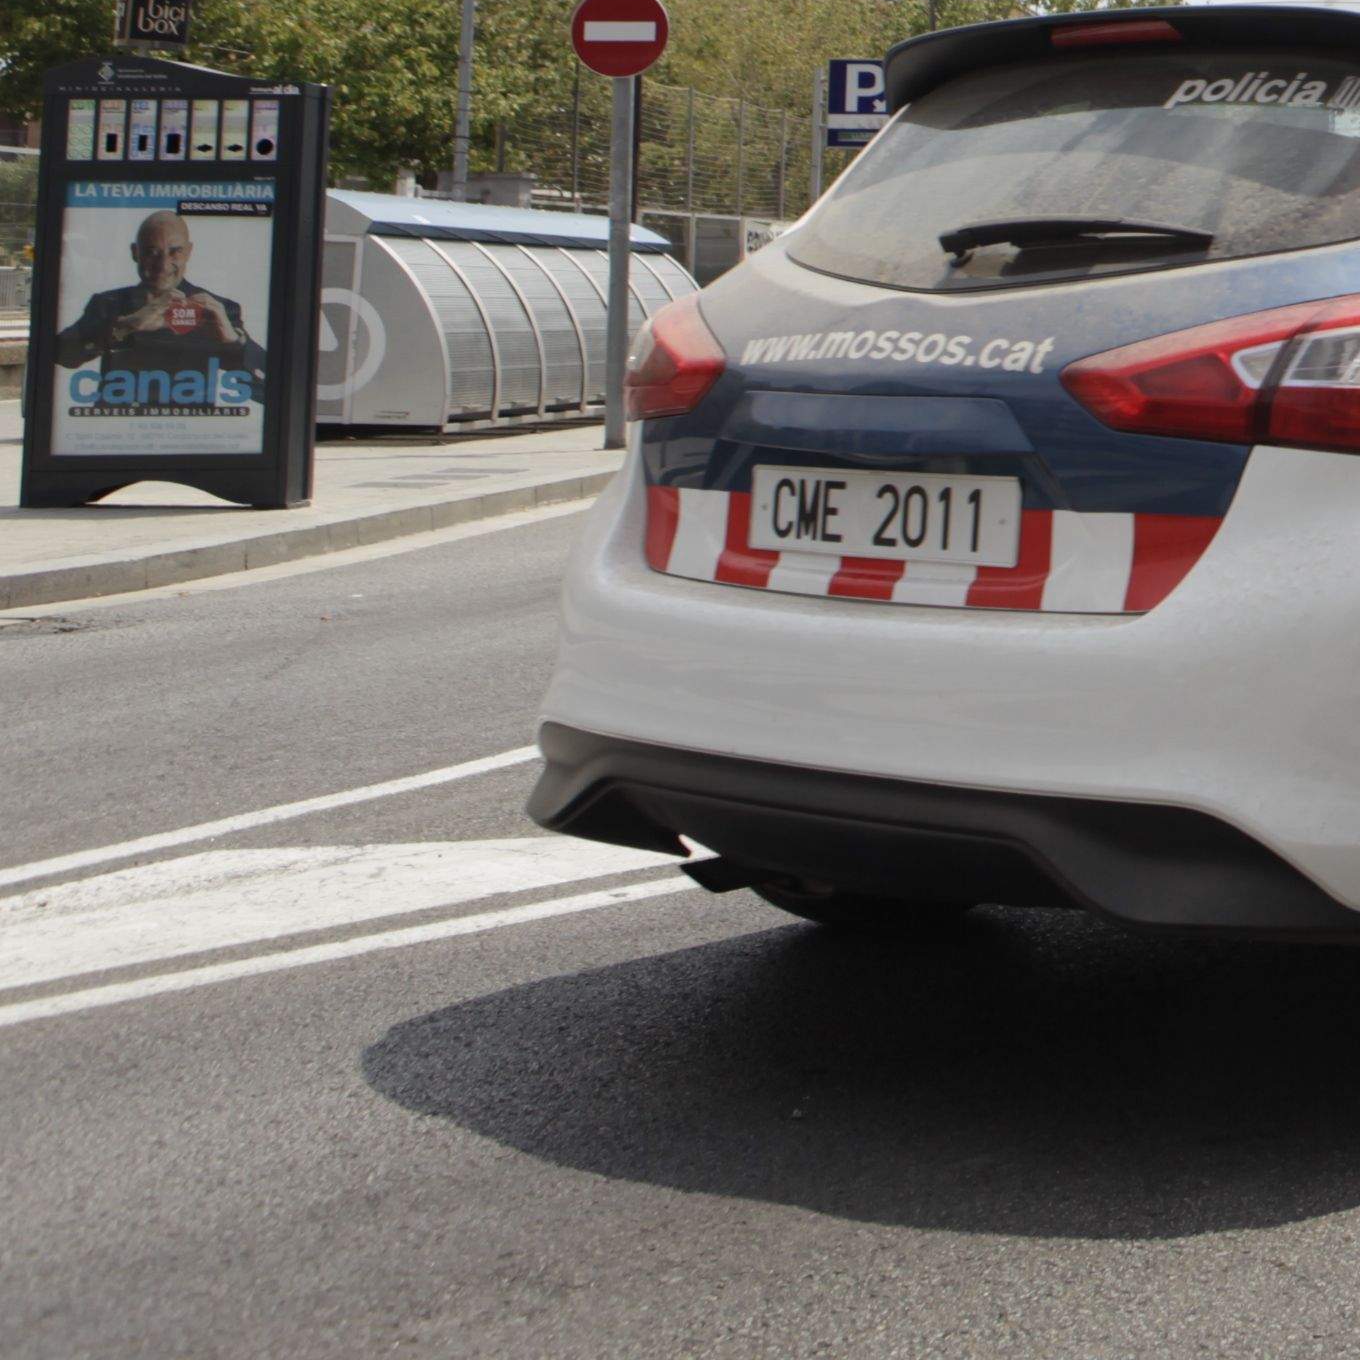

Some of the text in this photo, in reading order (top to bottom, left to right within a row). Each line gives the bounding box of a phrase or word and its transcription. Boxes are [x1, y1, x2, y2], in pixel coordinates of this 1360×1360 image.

[138, 6, 179, 36] box
[845, 63, 886, 112] P
[1163, 72, 1328, 109] policia
[75, 181, 274, 199] LA TEVA IMMOBILIÀRIA
[172, 308, 196, 319] SOM
[740, 330, 1055, 374] www.mossos.cat
[69, 357, 252, 405] canals
[73, 408, 136, 416] SERVEIS
[772, 478, 983, 553] CME 2011
